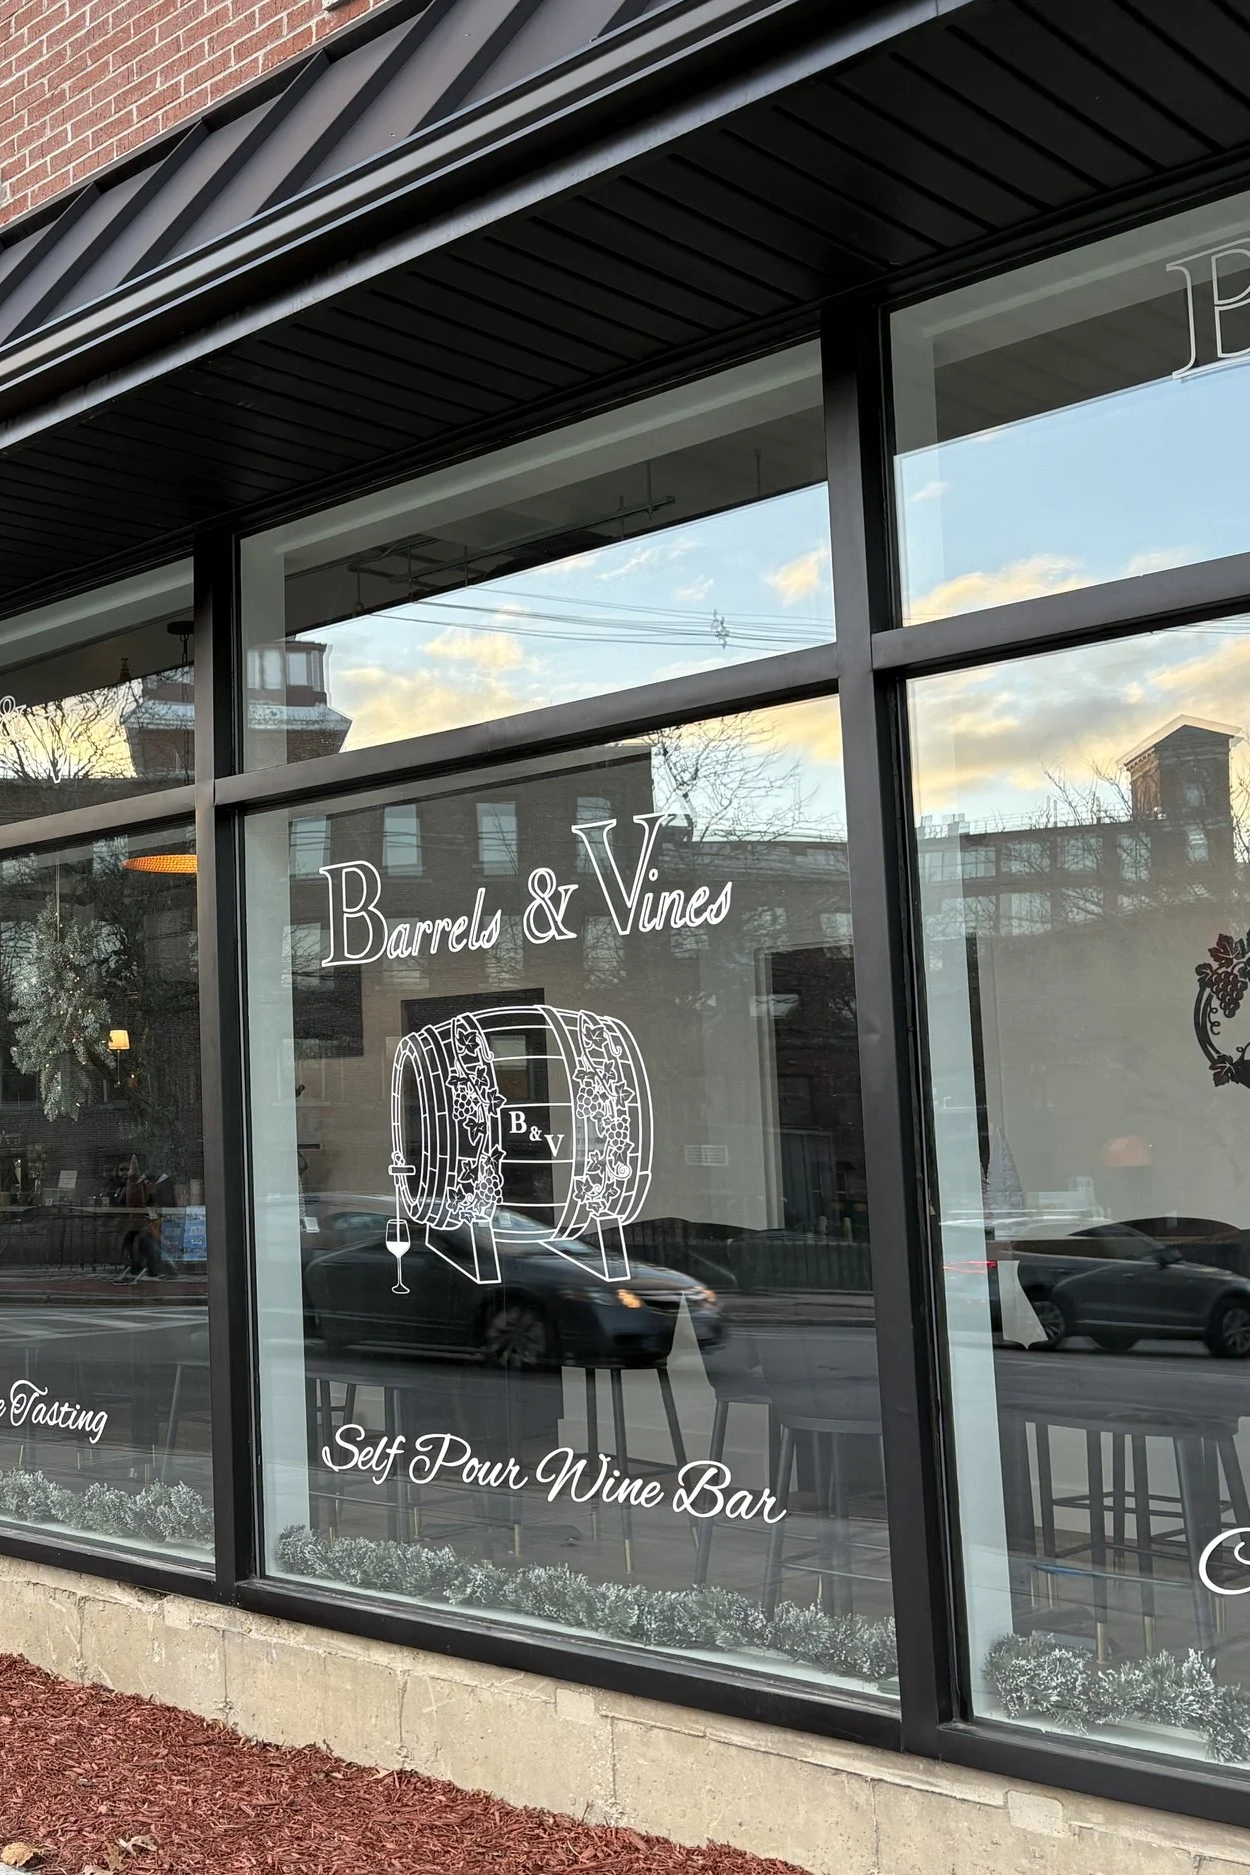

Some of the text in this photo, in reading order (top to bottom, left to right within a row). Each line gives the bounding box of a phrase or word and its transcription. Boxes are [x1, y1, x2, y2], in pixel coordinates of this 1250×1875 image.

[319, 812, 733, 967] Barrels & Vines
[509, 1111, 565, 1157] B & V
[10, 1379, 108, 1444] Tasting
[322, 1423, 787, 1525] Self Pour Wine Bar
